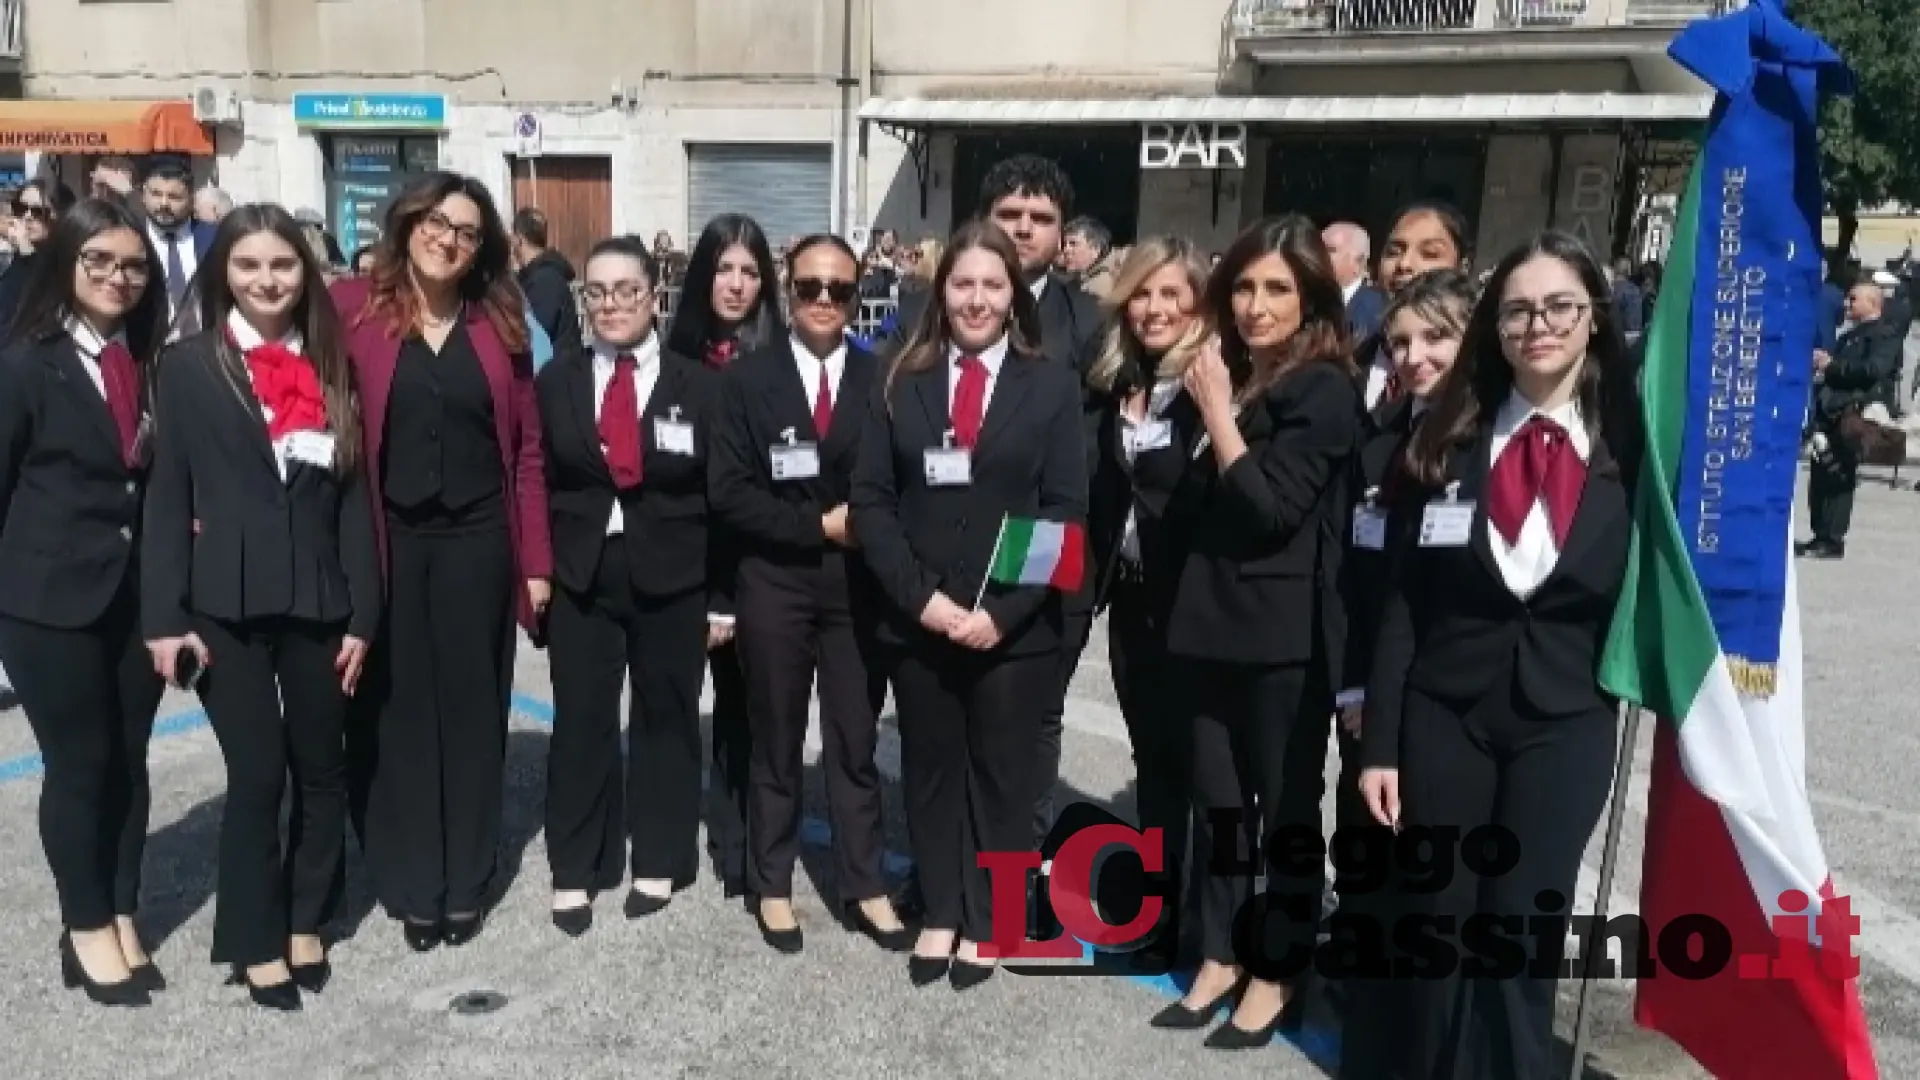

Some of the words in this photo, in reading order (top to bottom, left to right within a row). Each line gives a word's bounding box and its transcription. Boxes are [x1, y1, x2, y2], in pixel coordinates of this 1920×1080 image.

[1140, 121, 1246, 168] BAR
[1697, 451, 1725, 554] ISTITUTO
[1717, 165, 1747, 304] SUPERIORE
[1734, 265, 1767, 408] BENEDETTO
[1731, 410, 1755, 460] SAN
